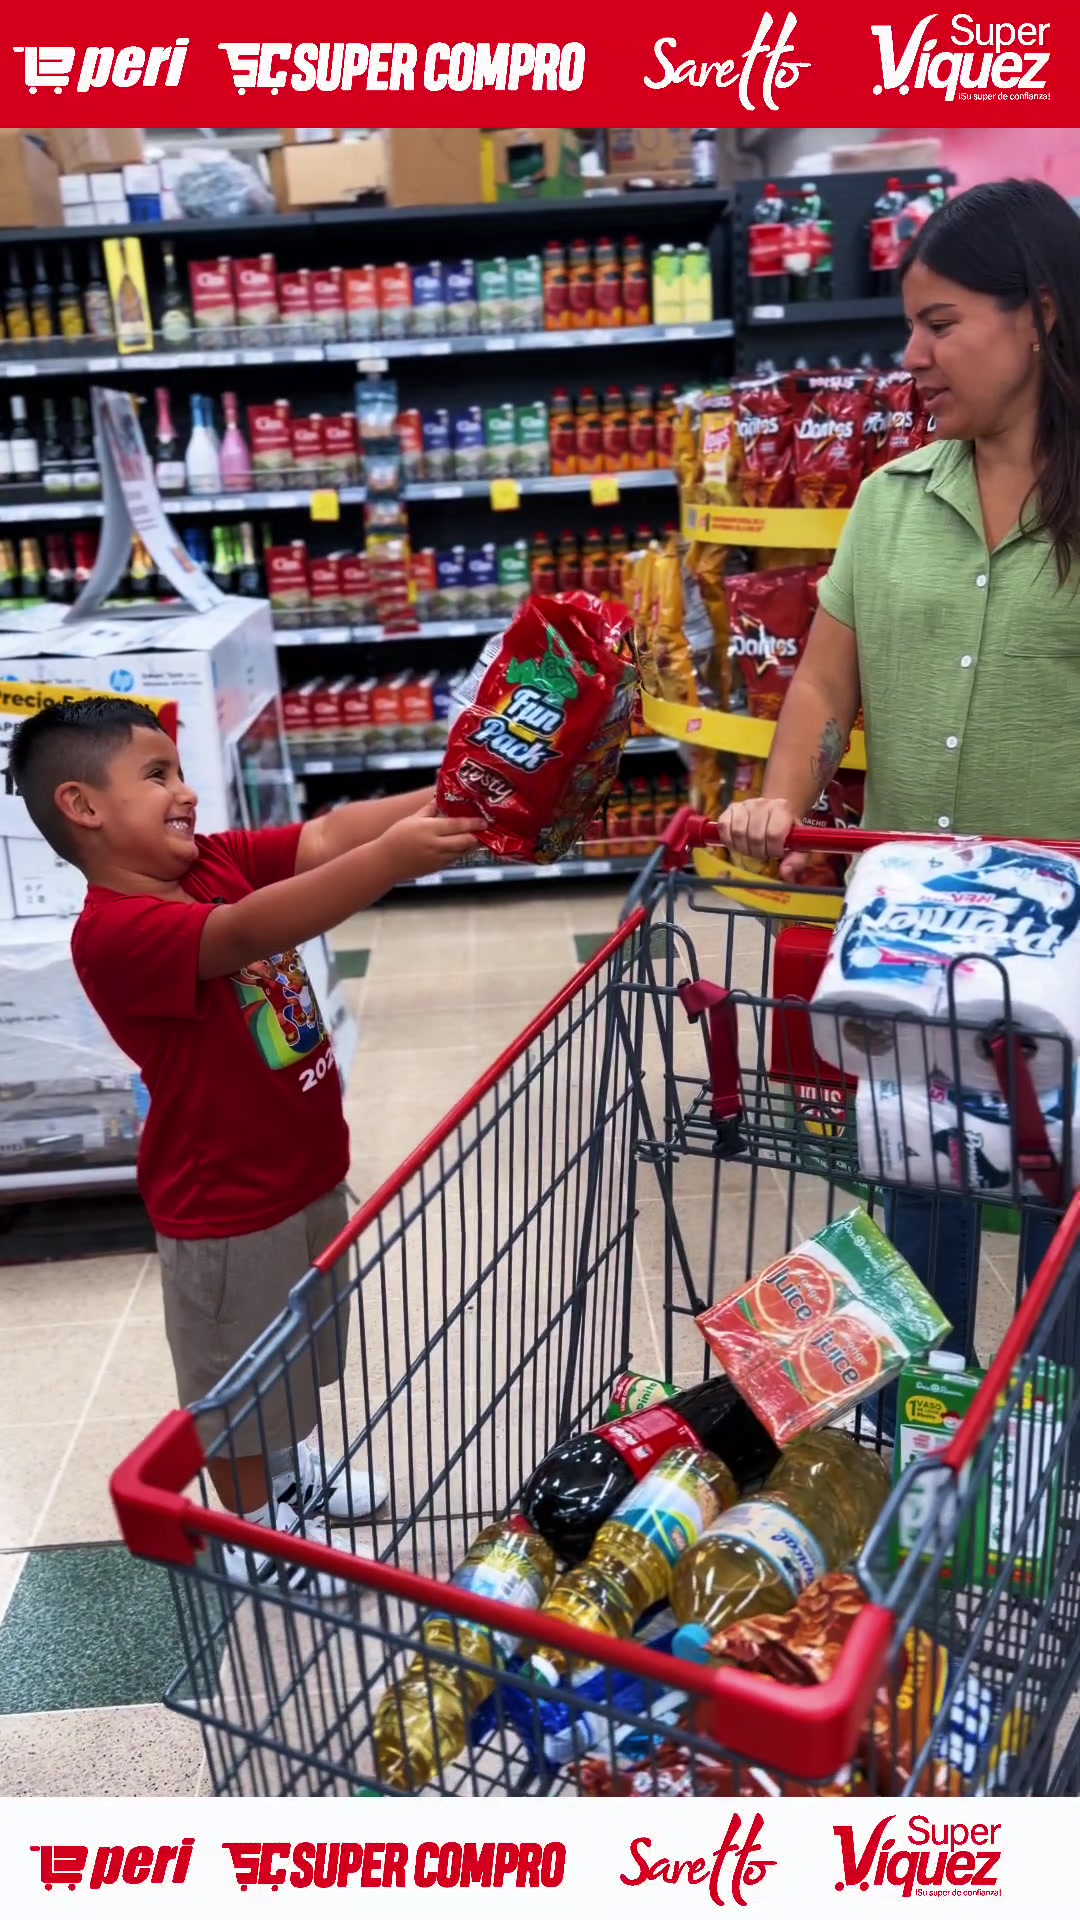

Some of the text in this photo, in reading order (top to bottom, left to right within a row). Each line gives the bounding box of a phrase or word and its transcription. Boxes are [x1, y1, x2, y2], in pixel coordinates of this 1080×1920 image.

[798, 418, 854, 440] Doritos
[728, 632, 798, 658] Doritos
[0, 690, 55, 710] recio
[507, 687, 564, 733] Fun
[474, 718, 550, 771] Pack
[459, 758, 513, 804] Tosty
[861, 903, 1063, 957] Premier
[917, 1399, 943, 1411] VASO
[771, 1531, 816, 1585] opical
